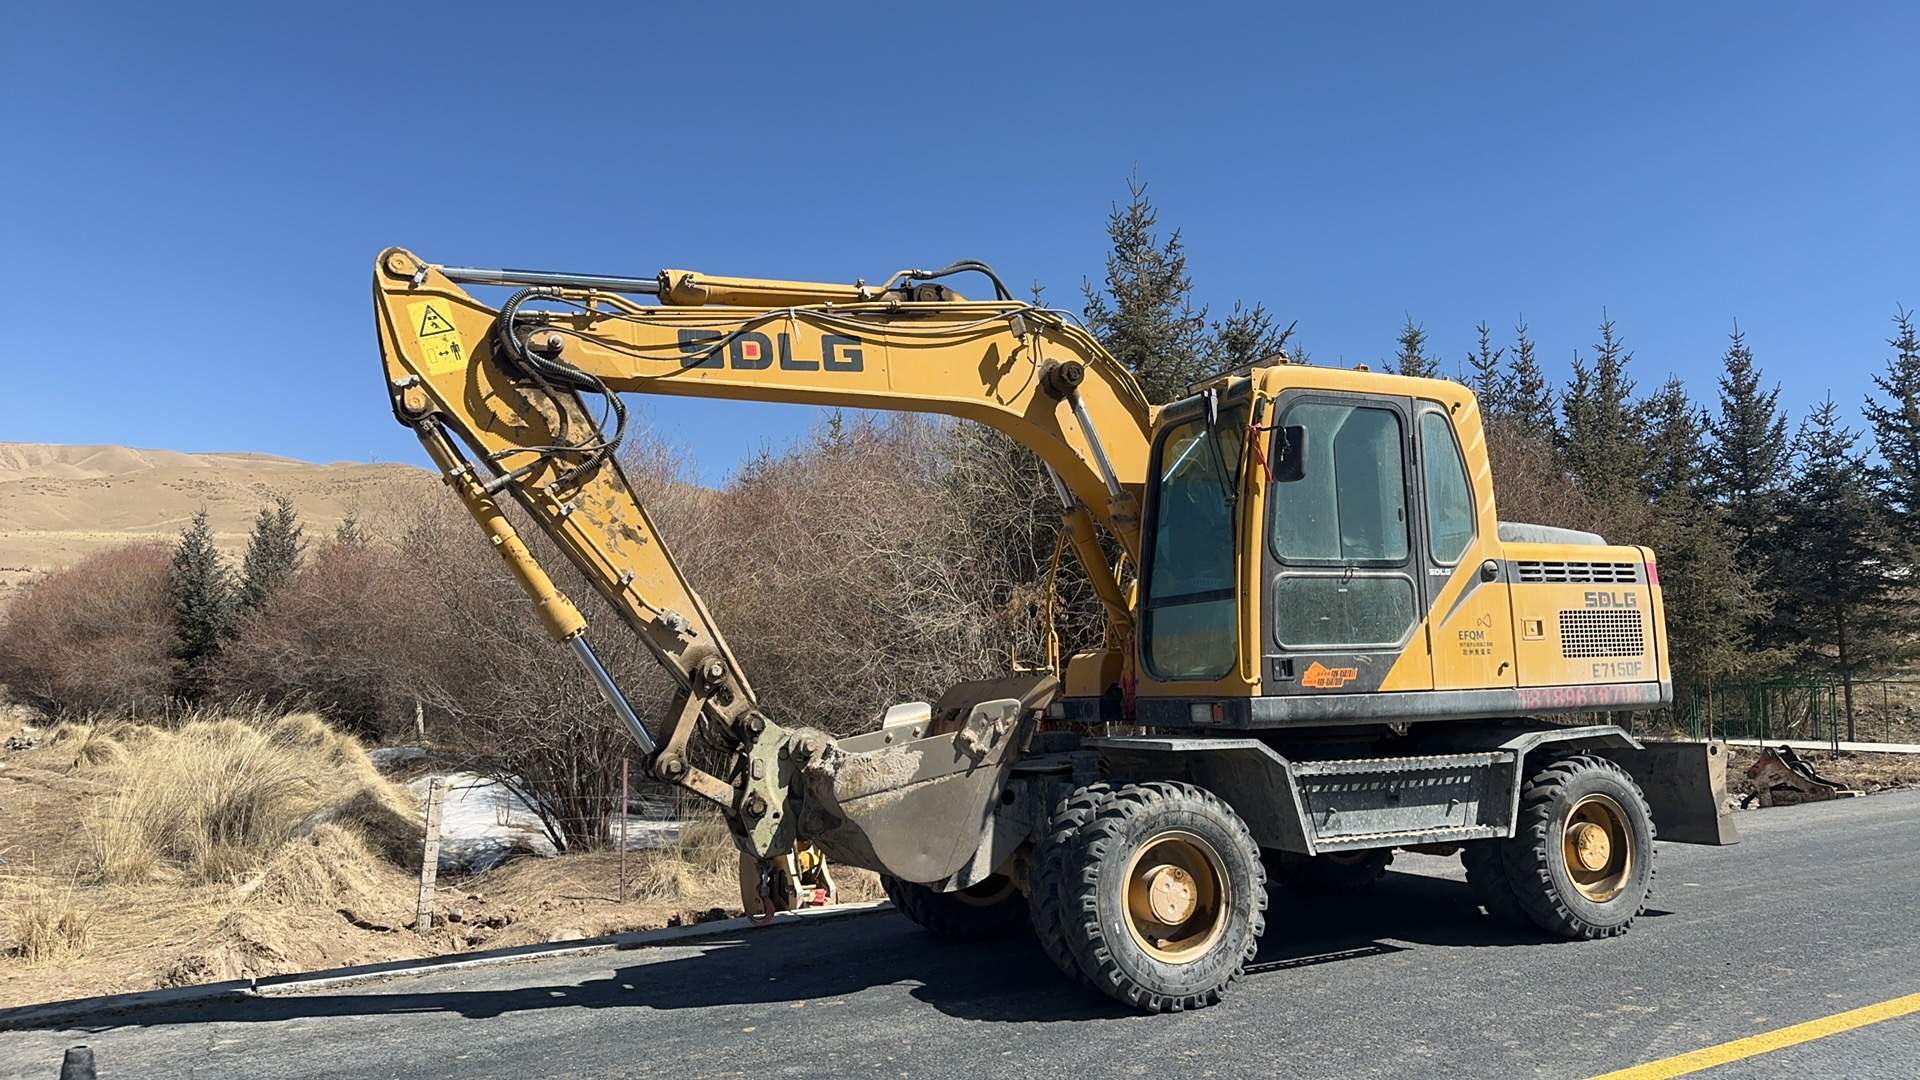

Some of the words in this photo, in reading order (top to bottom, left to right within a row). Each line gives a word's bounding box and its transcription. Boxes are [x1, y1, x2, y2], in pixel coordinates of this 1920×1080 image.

[678, 329, 864, 371] SDLG
[1584, 591, 1637, 608] SDLG
[1458, 630, 1485, 641] EFQM
[1592, 661, 1642, 678] E7150F
